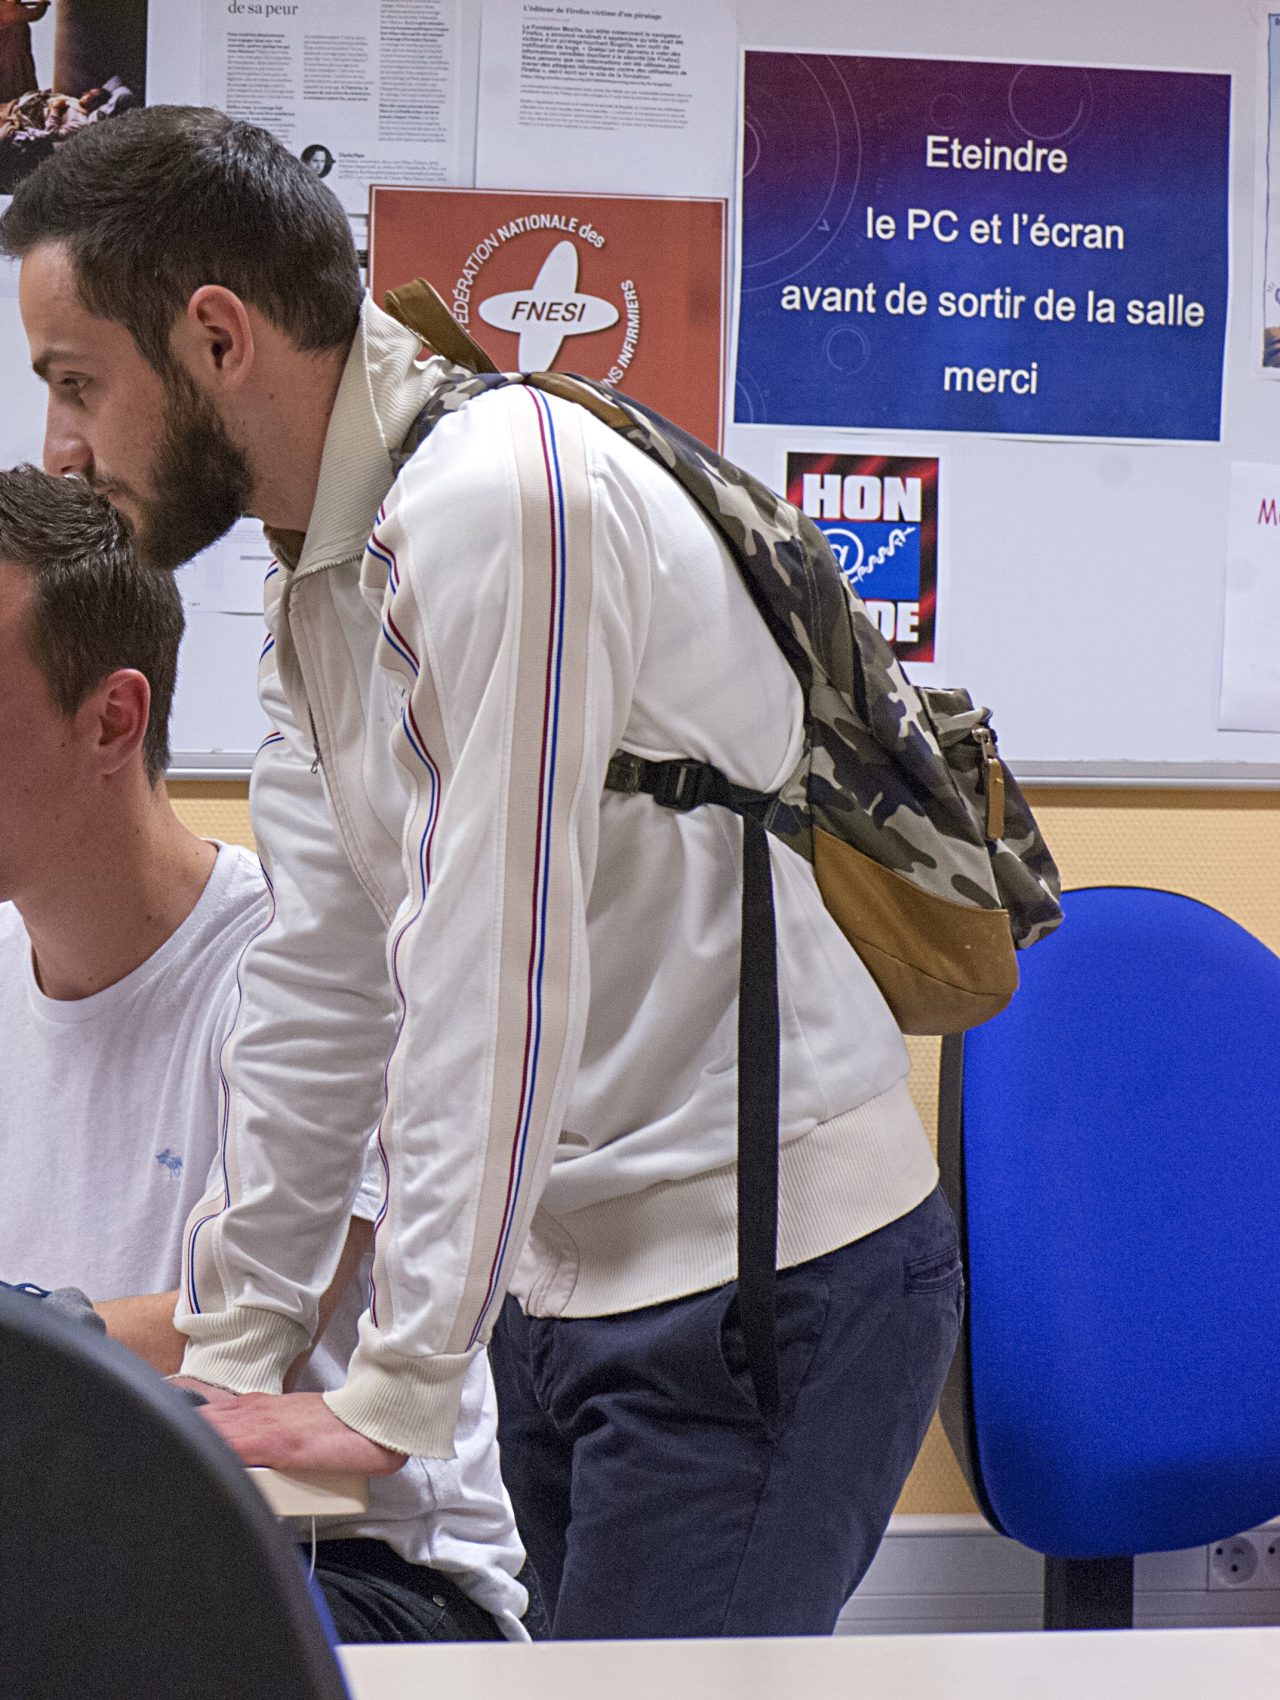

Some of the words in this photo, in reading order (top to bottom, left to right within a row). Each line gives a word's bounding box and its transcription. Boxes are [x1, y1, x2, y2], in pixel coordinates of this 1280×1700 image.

[228, 0, 245, 14] de
[247, 3, 263, 14] sa
[265, 5, 299, 18] peur
[926, 135, 1068, 174] Eteindre
[867, 206, 895, 238] le
[907, 210, 958, 243] PC
[969, 213, 1002, 245] et
[1012, 213, 1124, 249] l’écran
[452, 233, 500, 332] ÉDÉRATION
[496, 214, 579, 241] NATIONALE
[578, 223, 606, 249] des
[511, 301, 587, 322] FNESI
[617, 279, 640, 369] INFIRMIERS
[781, 284, 876, 313] avant
[885, 282, 927, 315] de
[938, 286, 1025, 319] sortir
[1033, 289, 1076, 322] de
[1087, 291, 1115, 324] la
[1126, 293, 1205, 327] salle
[942, 362, 1038, 394] merci
[801, 473, 922, 522] HON
[1257, 498, 1280, 526] M
[865, 600, 920, 643] DE
